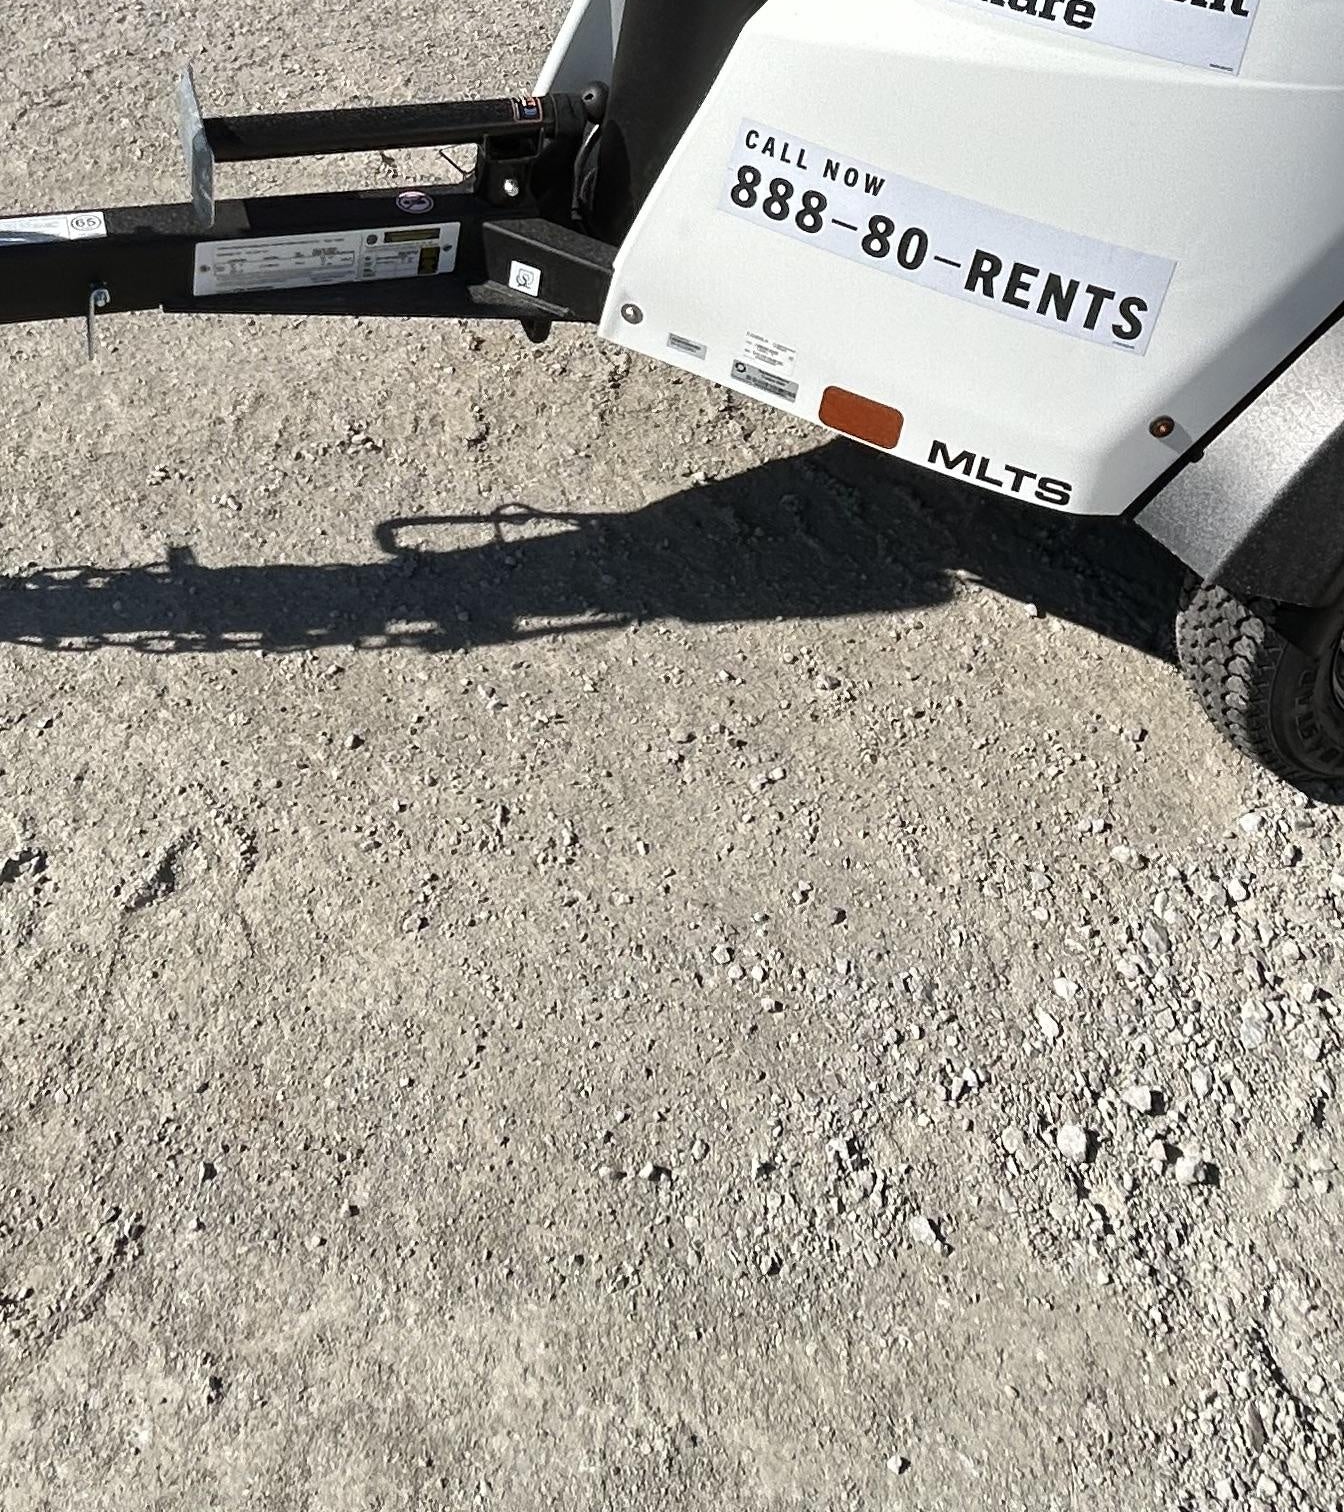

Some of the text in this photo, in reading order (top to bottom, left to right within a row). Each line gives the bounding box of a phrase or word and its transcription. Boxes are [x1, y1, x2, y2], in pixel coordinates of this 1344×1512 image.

[745, 129, 886, 197] CALL NOW
[75, 218, 96, 228] 65
[730, 165, 1149, 342] 888-80-RENTS
[927, 439, 1073, 506] MLTS
